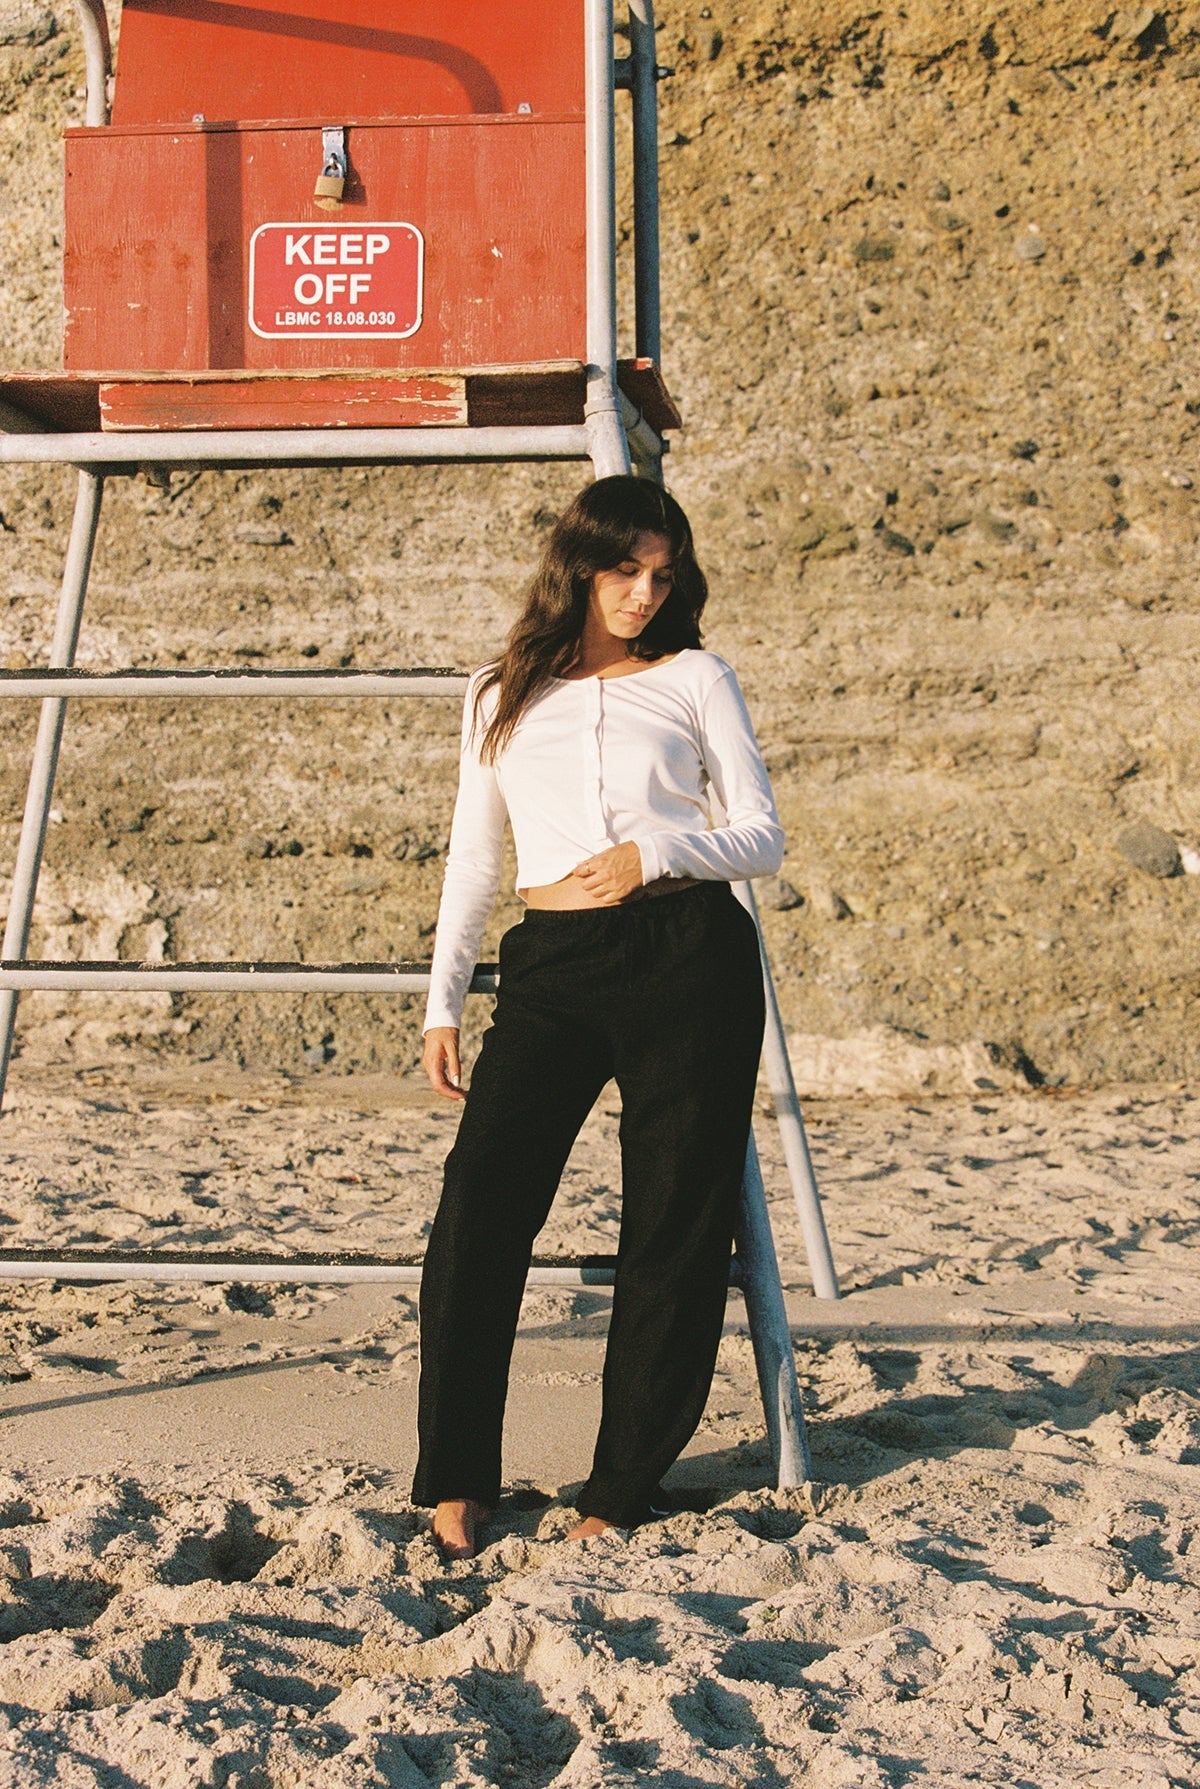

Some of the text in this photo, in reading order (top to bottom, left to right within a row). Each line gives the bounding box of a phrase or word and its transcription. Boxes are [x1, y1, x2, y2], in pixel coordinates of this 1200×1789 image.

[285, 233, 391, 265] KEEP
[293, 273, 372, 305] OFF
[275, 311, 396, 326] LBMC 18.08.030
